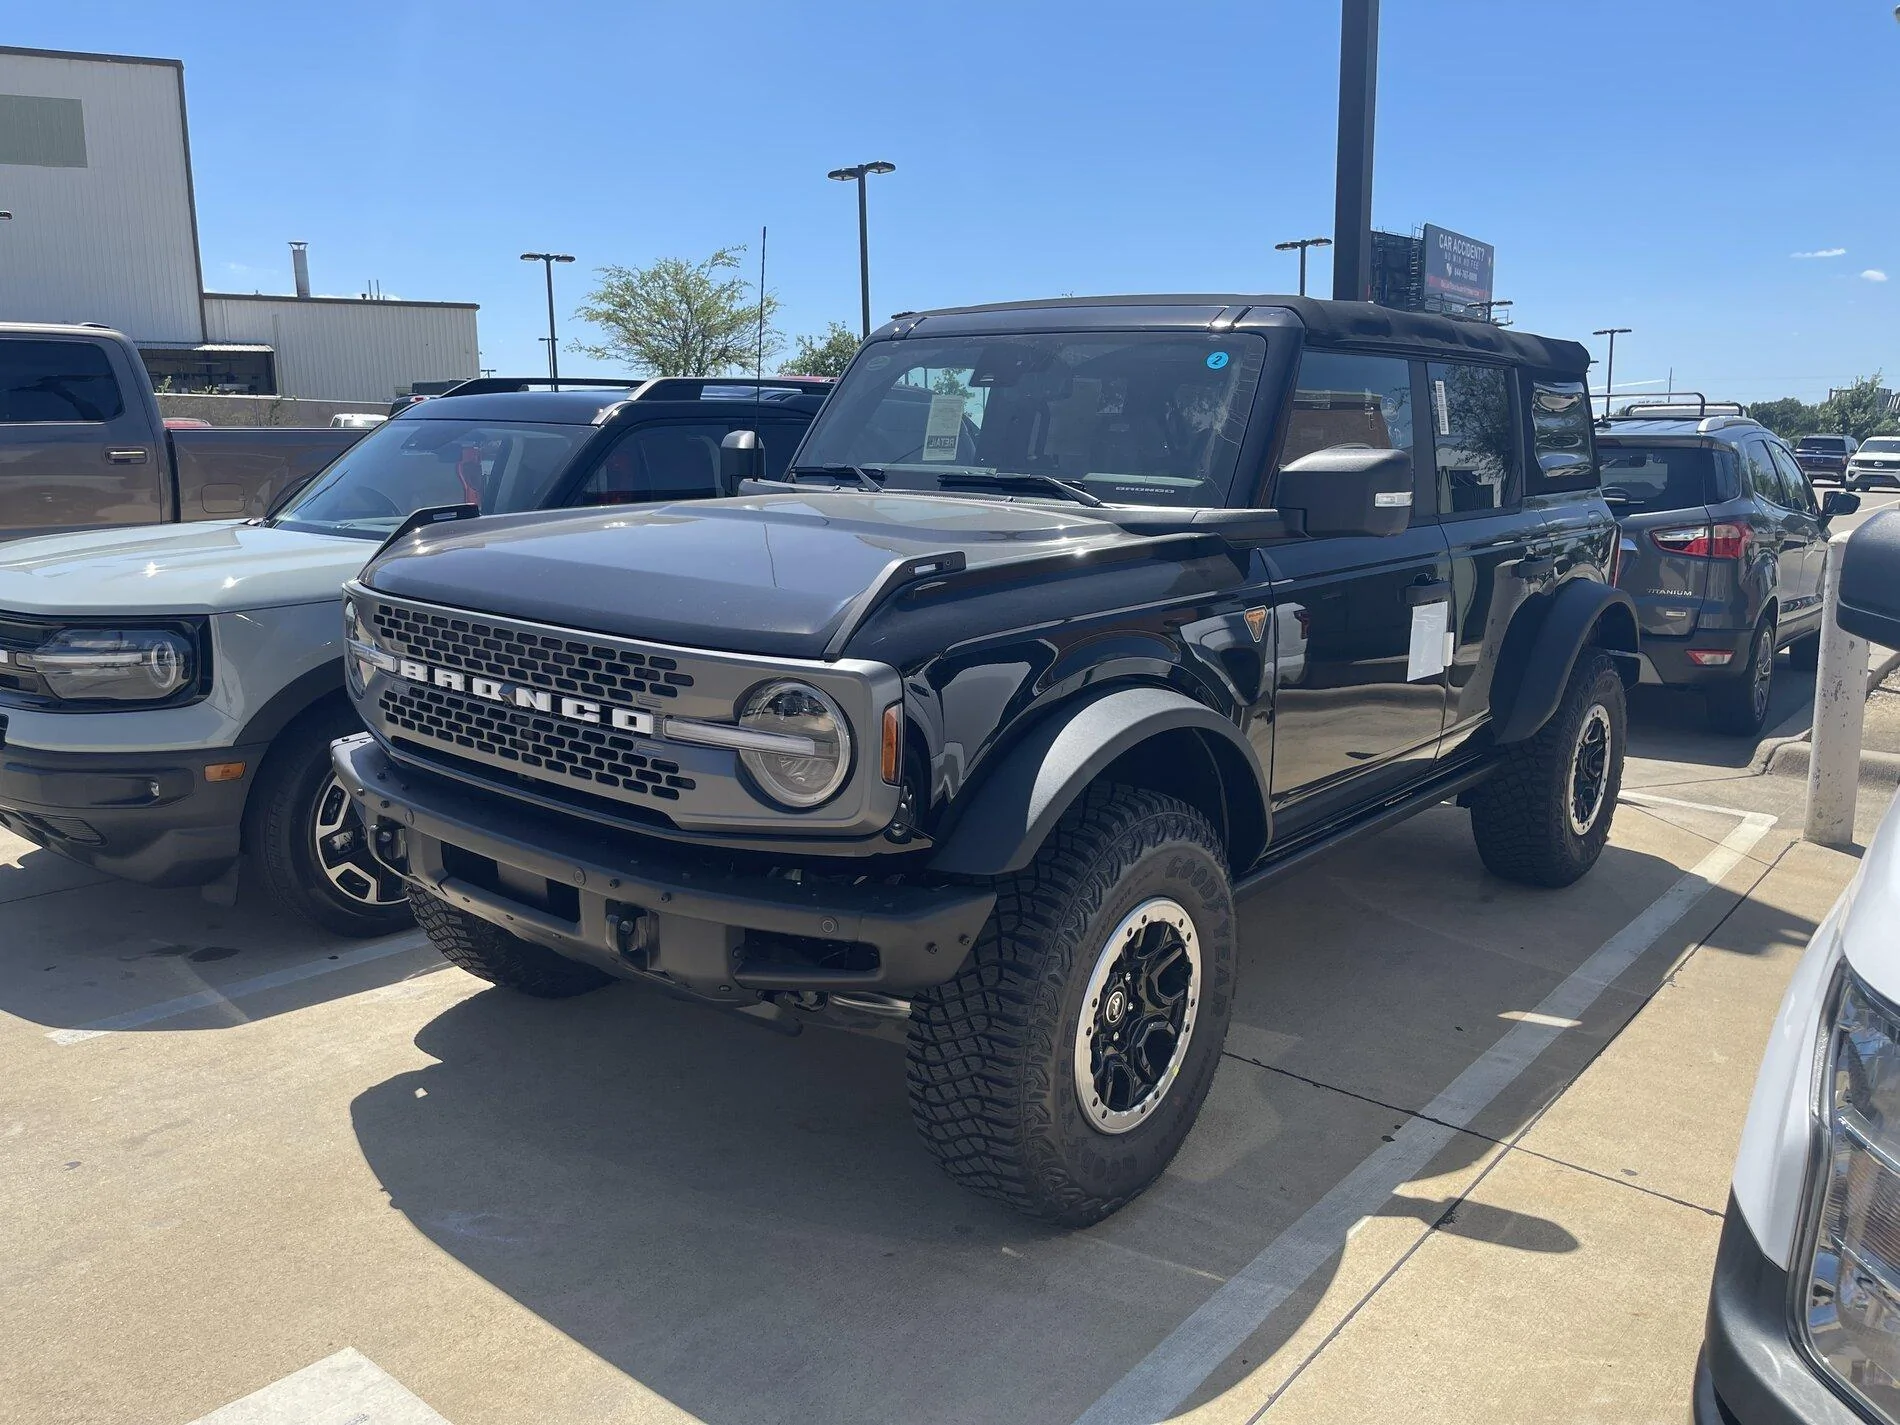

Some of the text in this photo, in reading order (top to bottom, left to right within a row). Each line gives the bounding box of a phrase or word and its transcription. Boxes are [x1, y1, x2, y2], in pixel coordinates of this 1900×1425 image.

[1439, 234, 1485, 262] CAR ACCIDENT?
[1211, 355, 1223, 366] 2
[1115, 486, 1175, 494] BRONCO
[1647, 588, 1692, 596] TITANIUM
[400, 659, 654, 735] BRONCO
[1165, 855, 1231, 1017] GOODYEAR
